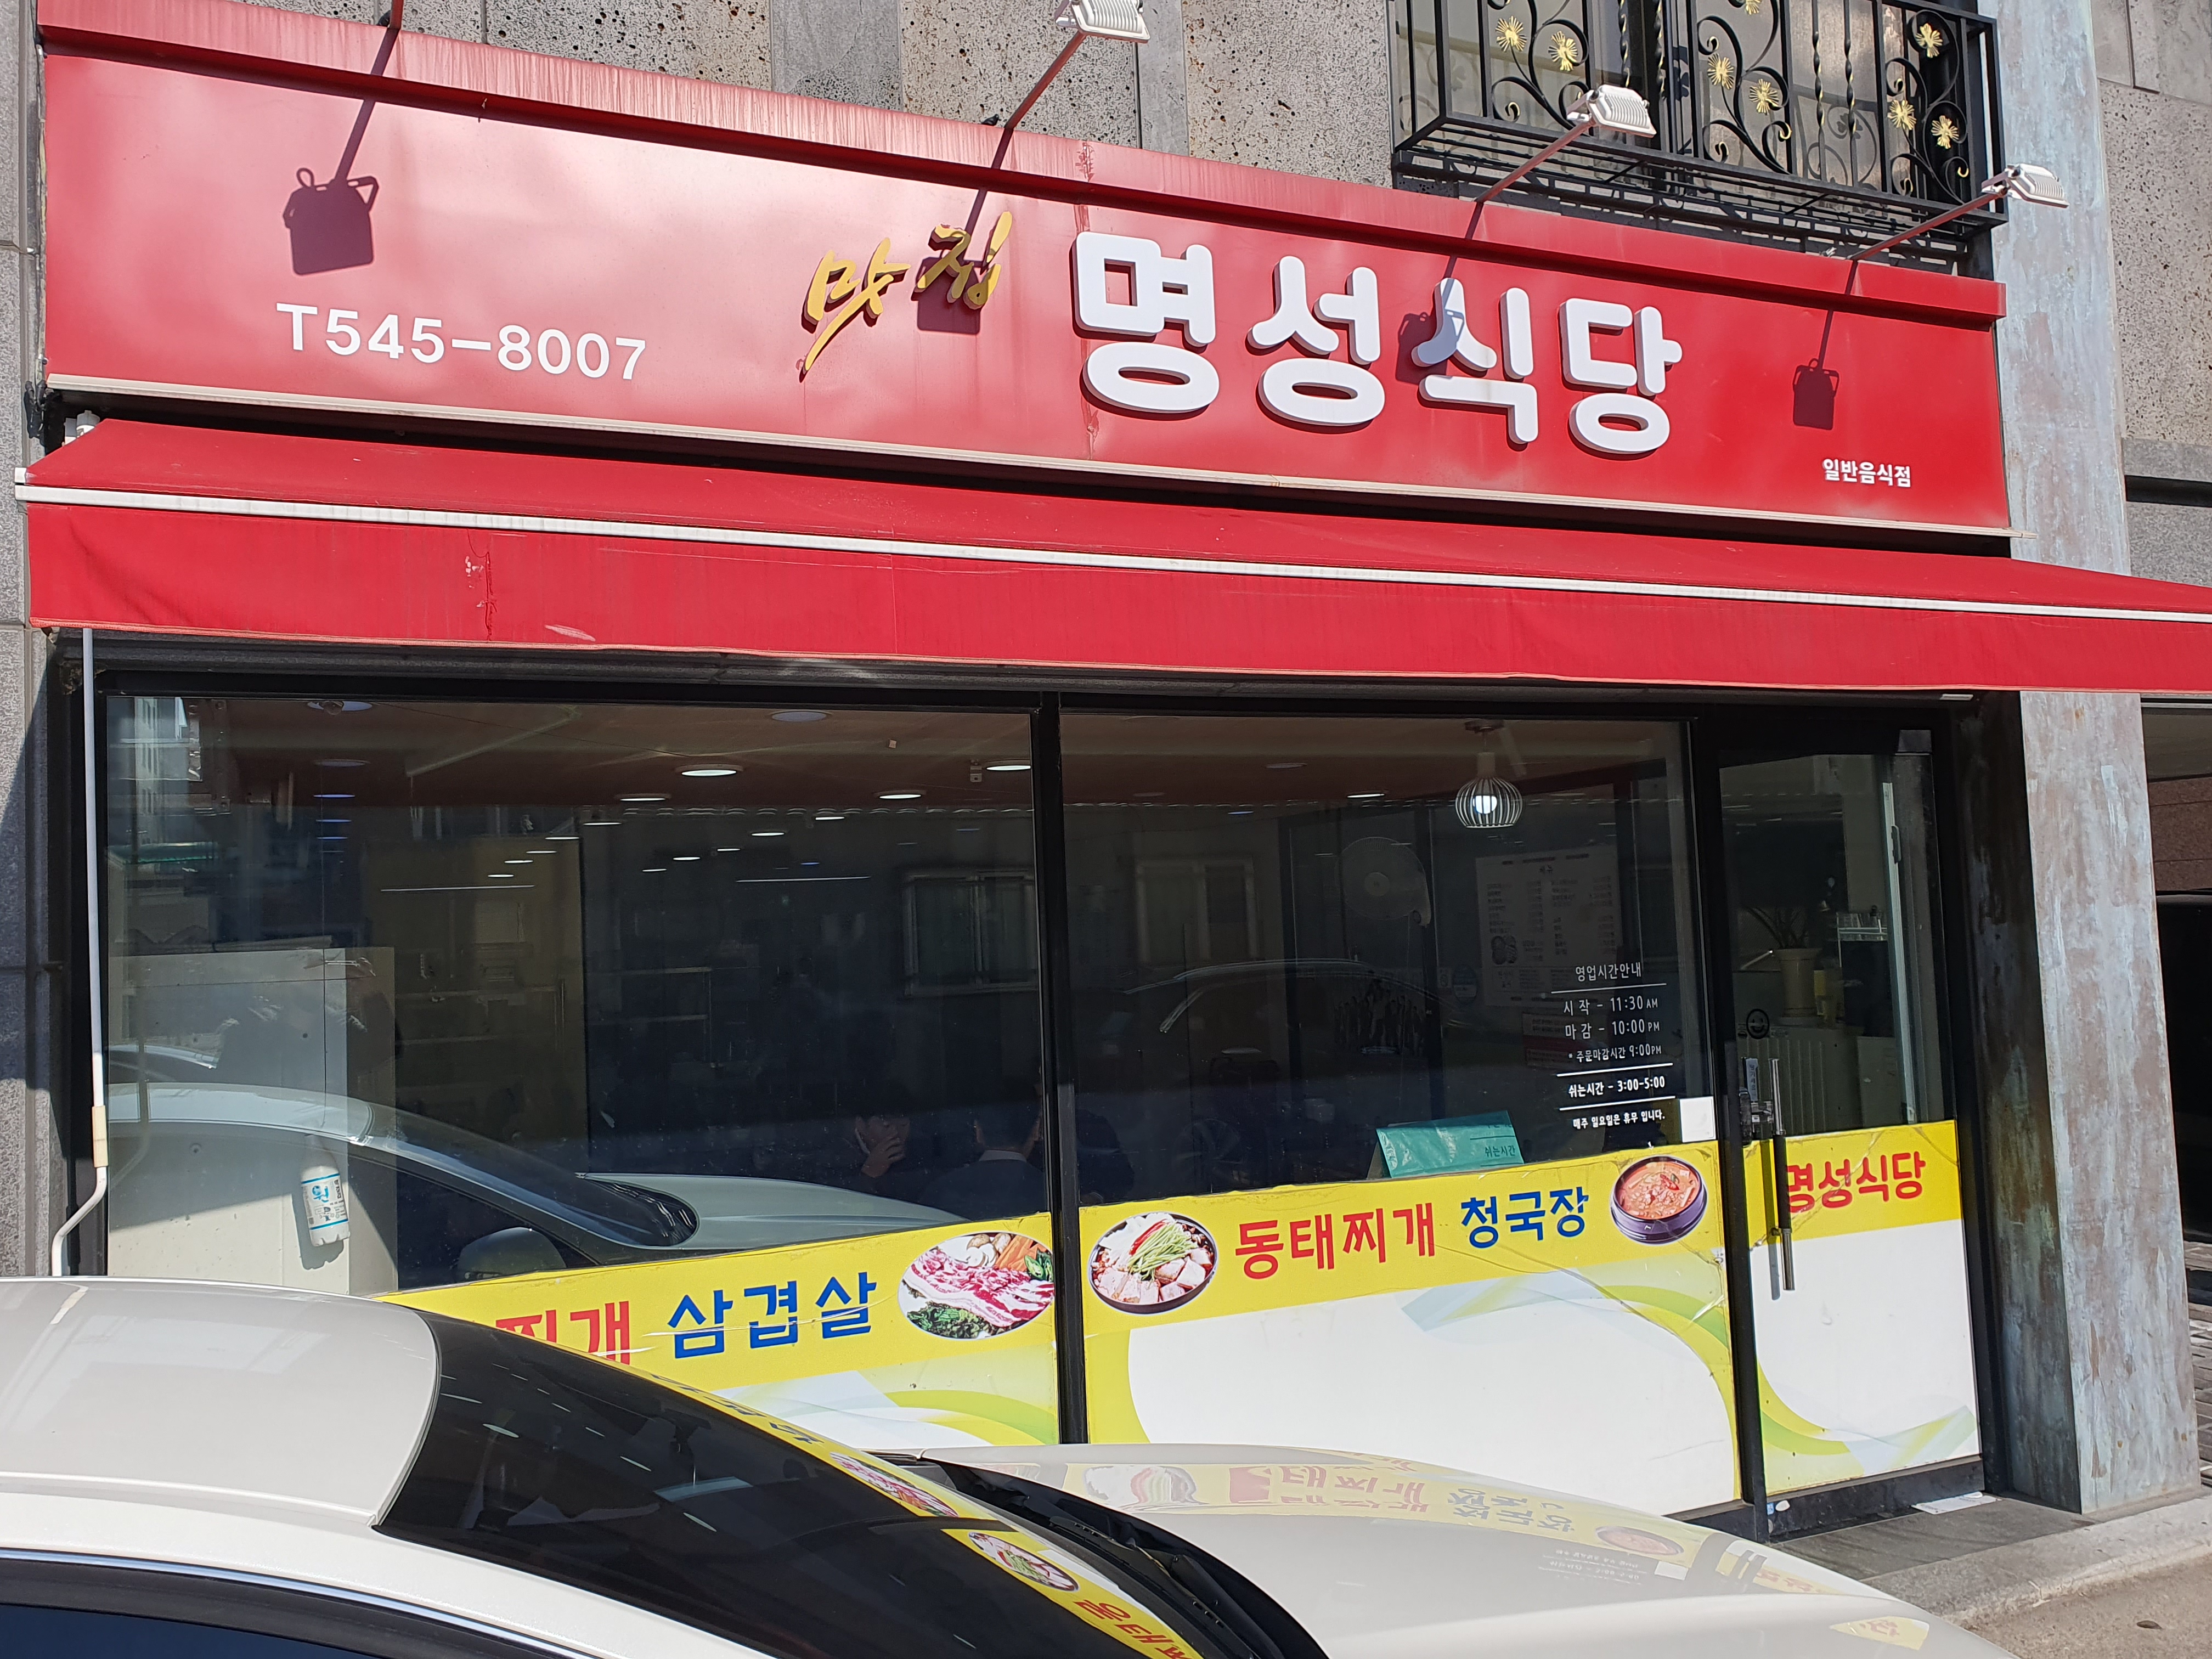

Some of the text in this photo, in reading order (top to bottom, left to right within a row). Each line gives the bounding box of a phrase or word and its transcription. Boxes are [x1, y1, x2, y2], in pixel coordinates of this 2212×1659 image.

[276, 302, 646, 380] T545-8007
[1075, 230, 1683, 453] 명성식당
[1822, 458, 1911, 488] 일반음식점
[1575, 961, 1642, 982] 영업시간안내
[1610, 995, 1644, 1012] 11:30
[1611, 1018, 1645, 1036] 10:00
[1576, 1046, 1627, 1063] 주문마감시간
[1568, 1081, 1605, 1098] 쉬는시간
[1617, 1075, 1666, 1093] 3:00-5:00
[1572, 1117, 1589, 1130] 매주
[1590, 1113, 1621, 1128] 일요일은
[1623, 1110, 1639, 1125] 휴무
[1484, 1145, 1516, 1158] 쉬는시간
[1787, 1151, 1927, 1214] 명성식당
[668, 1271, 877, 1359] 삼겹살
[1234, 1202, 1436, 1279] 동태찌개
[1460, 1186, 1589, 1249] 청국장
